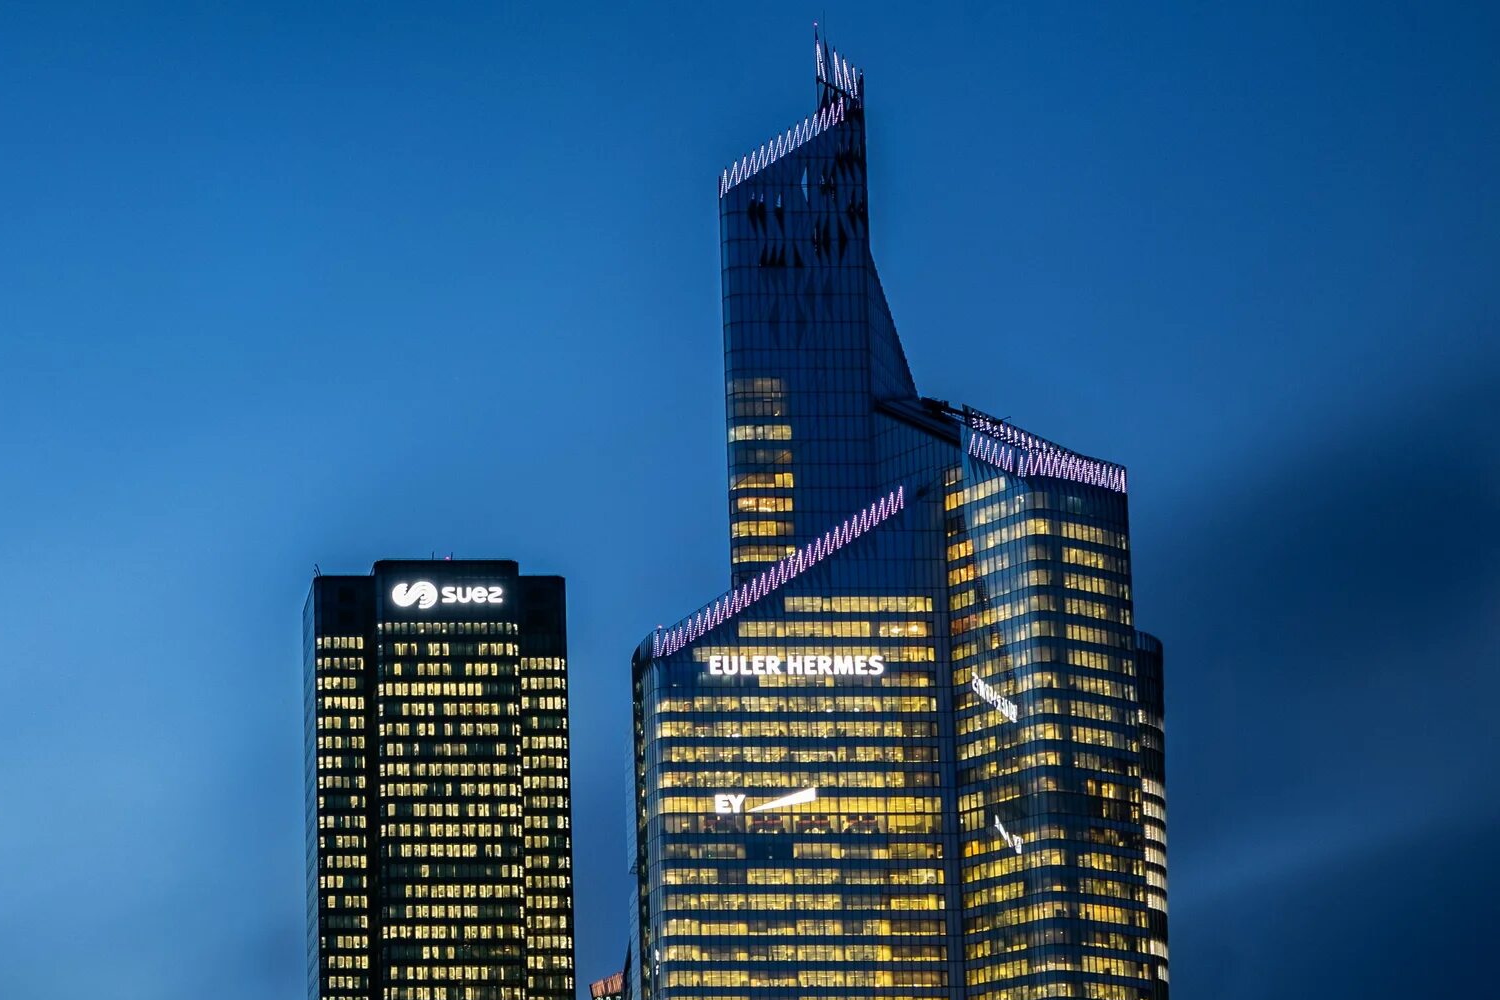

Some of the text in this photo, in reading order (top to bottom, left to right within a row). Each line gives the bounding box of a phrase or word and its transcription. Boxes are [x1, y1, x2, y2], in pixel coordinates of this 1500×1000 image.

[709, 655, 884, 676] EULER HERMES
[715, 794, 746, 814] EY
